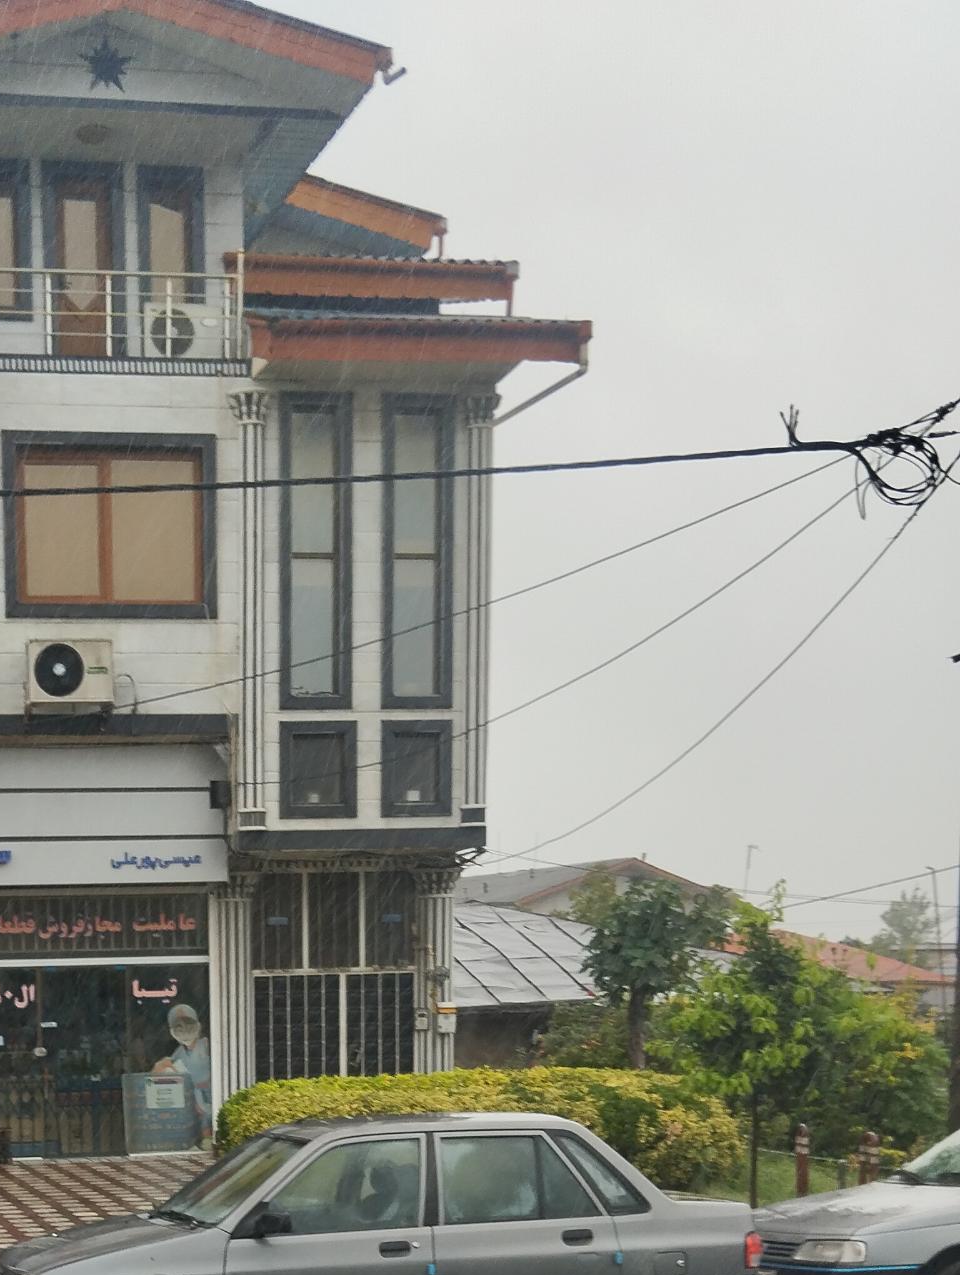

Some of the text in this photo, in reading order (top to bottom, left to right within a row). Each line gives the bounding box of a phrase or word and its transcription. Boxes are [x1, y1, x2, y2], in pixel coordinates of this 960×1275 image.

[38, 912, 86, 940] فروش
[132, 912, 197, 938] عاملیت
[132, 978, 179, 1005] تیبا
